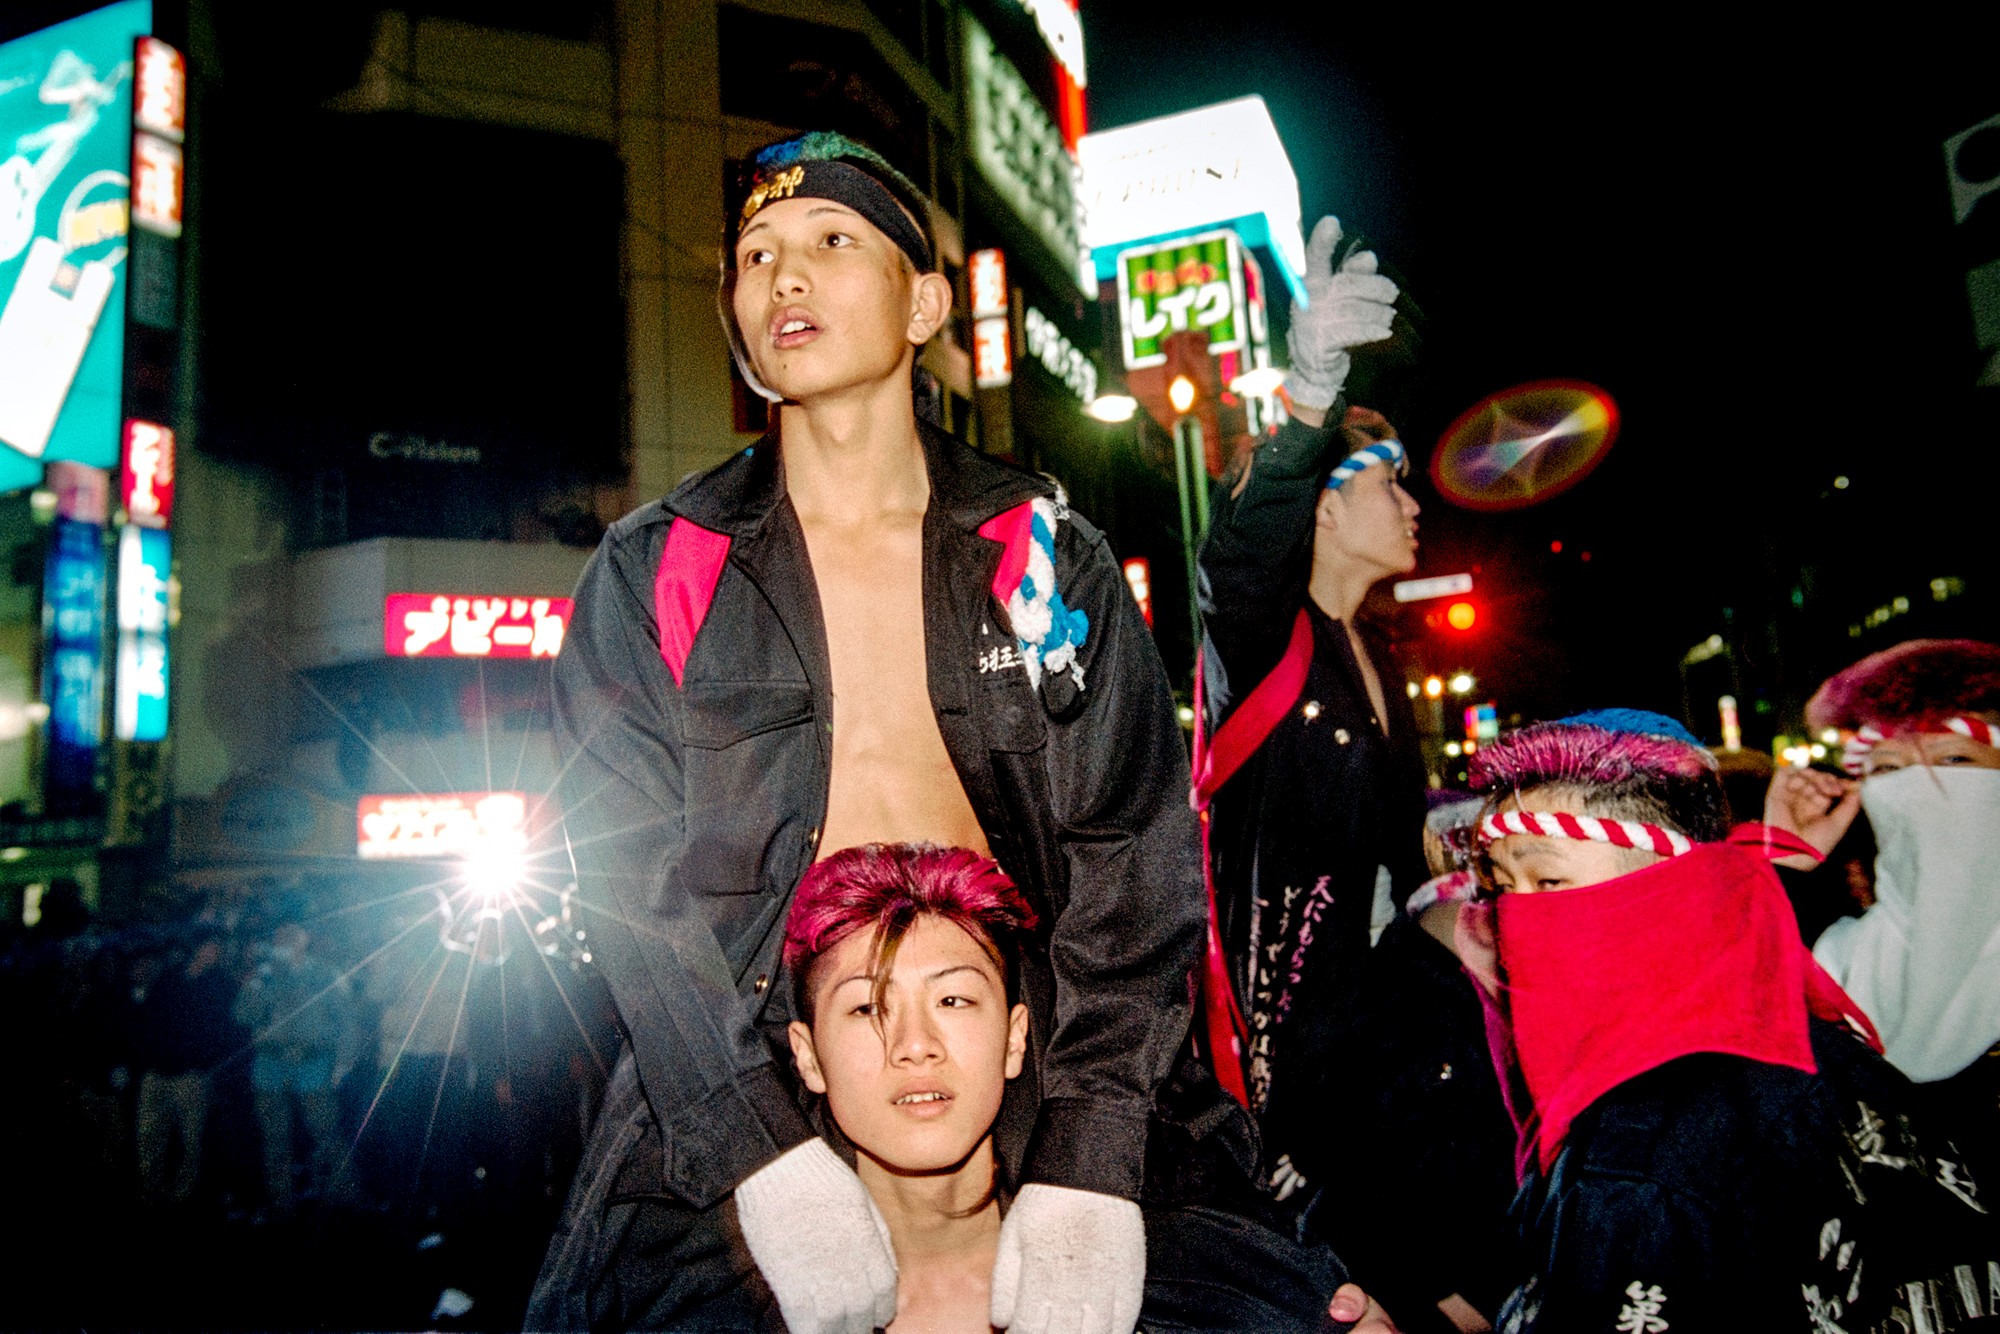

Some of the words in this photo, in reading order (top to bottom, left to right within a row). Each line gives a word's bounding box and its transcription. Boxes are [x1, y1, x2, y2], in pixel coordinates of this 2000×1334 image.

[1131, 280, 1232, 338] レイク
[1615, 1280, 1670, 1334] 第
